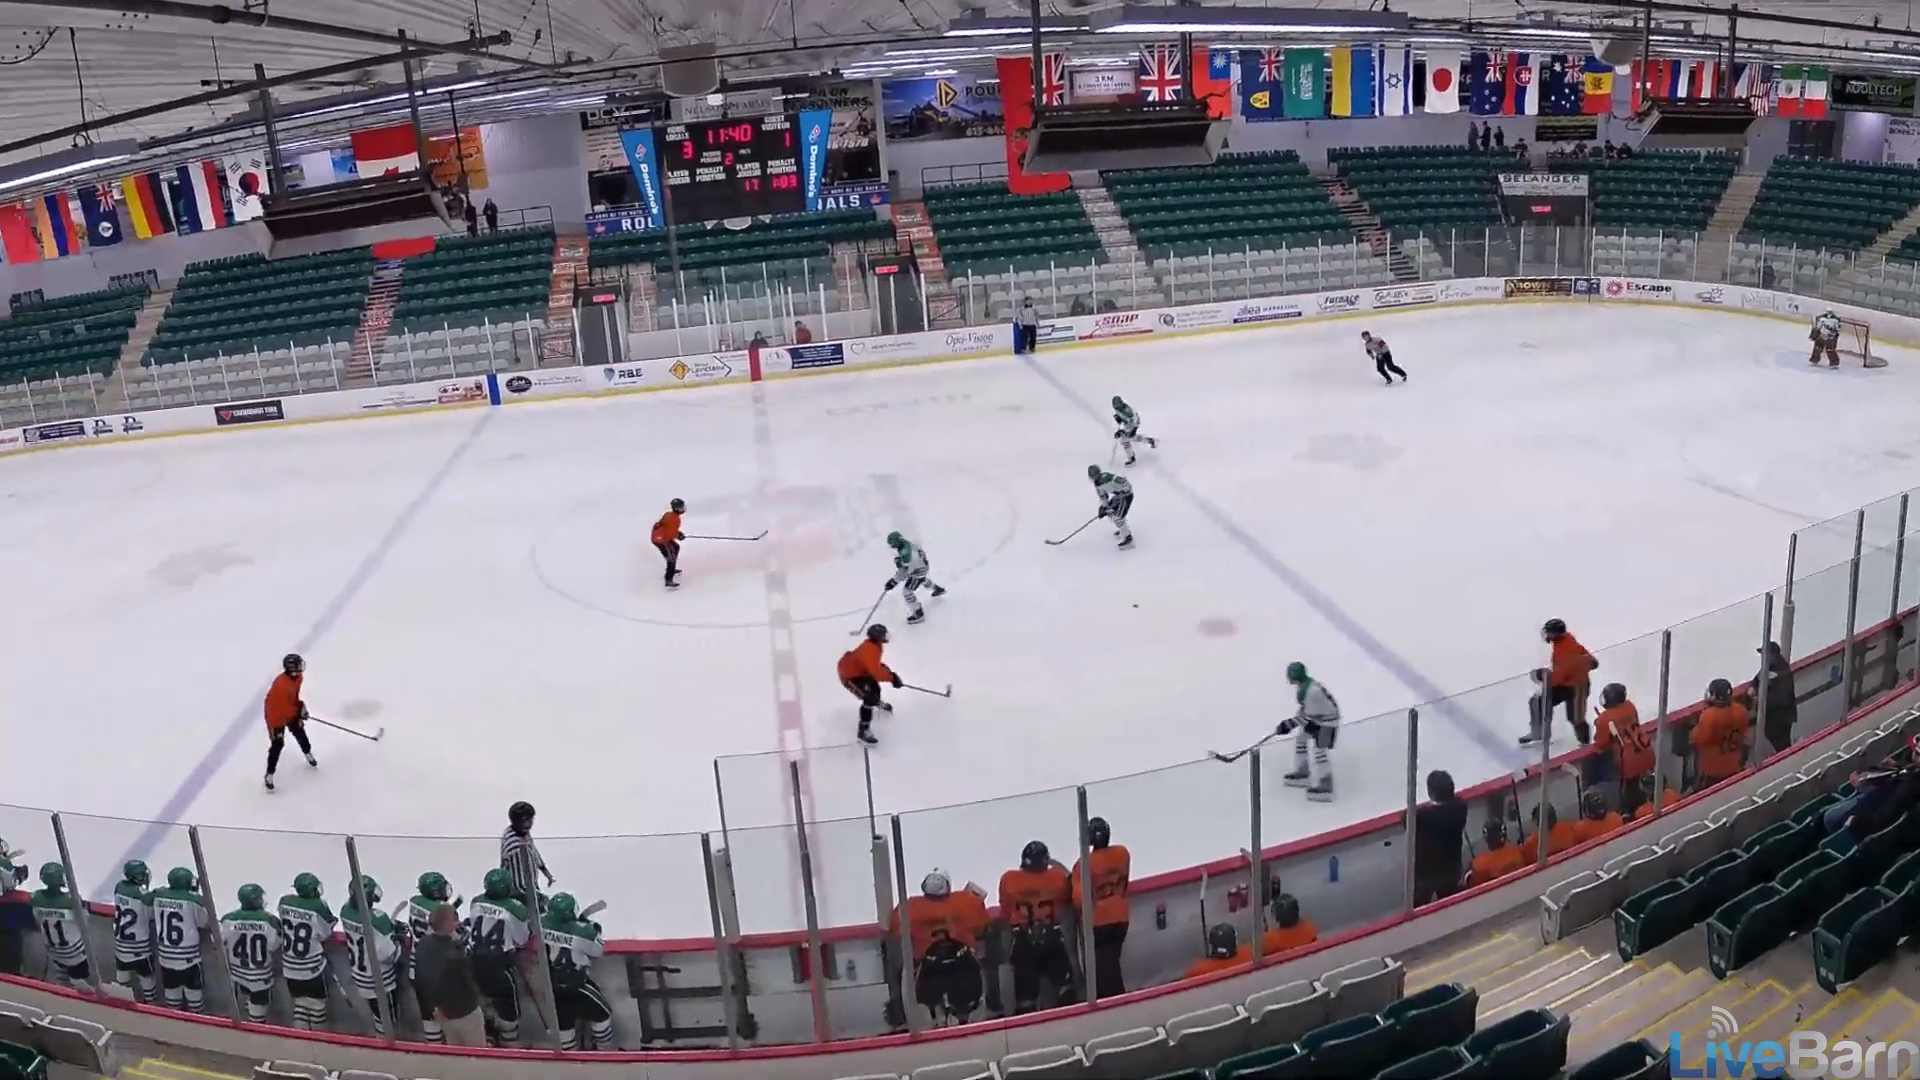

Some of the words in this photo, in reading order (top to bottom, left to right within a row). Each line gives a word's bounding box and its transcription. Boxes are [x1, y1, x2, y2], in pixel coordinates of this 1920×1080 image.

[707, 124, 752, 144] 11:40
[784, 132, 791, 147] 1
[682, 141, 694, 159] 3
[724, 152, 733, 165] 2
[667, 170, 689, 178] LAYER
[808, 144, 818, 198] Domino's
[1503, 174, 1581, 184] BELANGER
[639, 162, 659, 216] Domino's
[1626, 281, 1673, 293] Escape
[232, 933, 268, 968] 40
